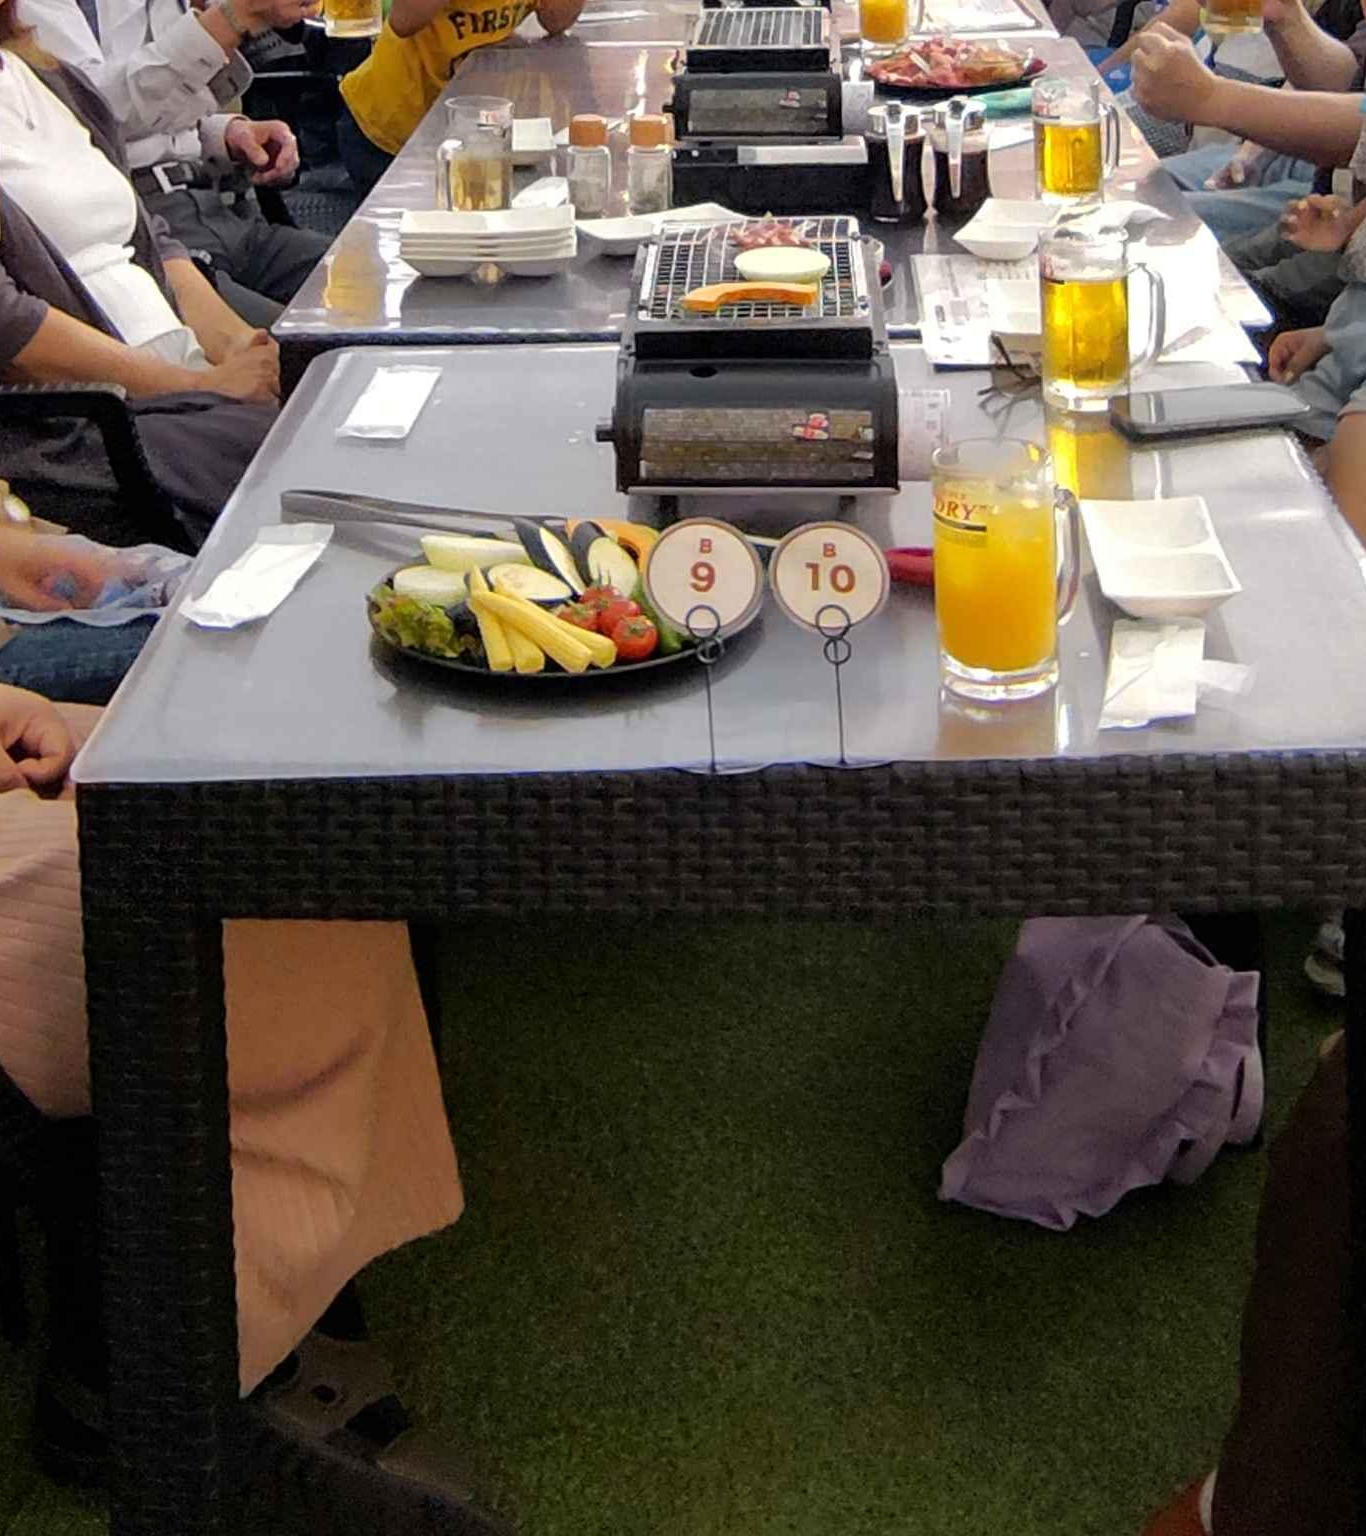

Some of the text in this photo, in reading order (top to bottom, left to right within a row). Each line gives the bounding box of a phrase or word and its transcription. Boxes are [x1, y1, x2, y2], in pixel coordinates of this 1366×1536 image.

[698, 538, 713, 554] B
[822, 542, 837, 558] B
[690, 561, 717, 593] 9
[804, 562, 857, 594] 10
